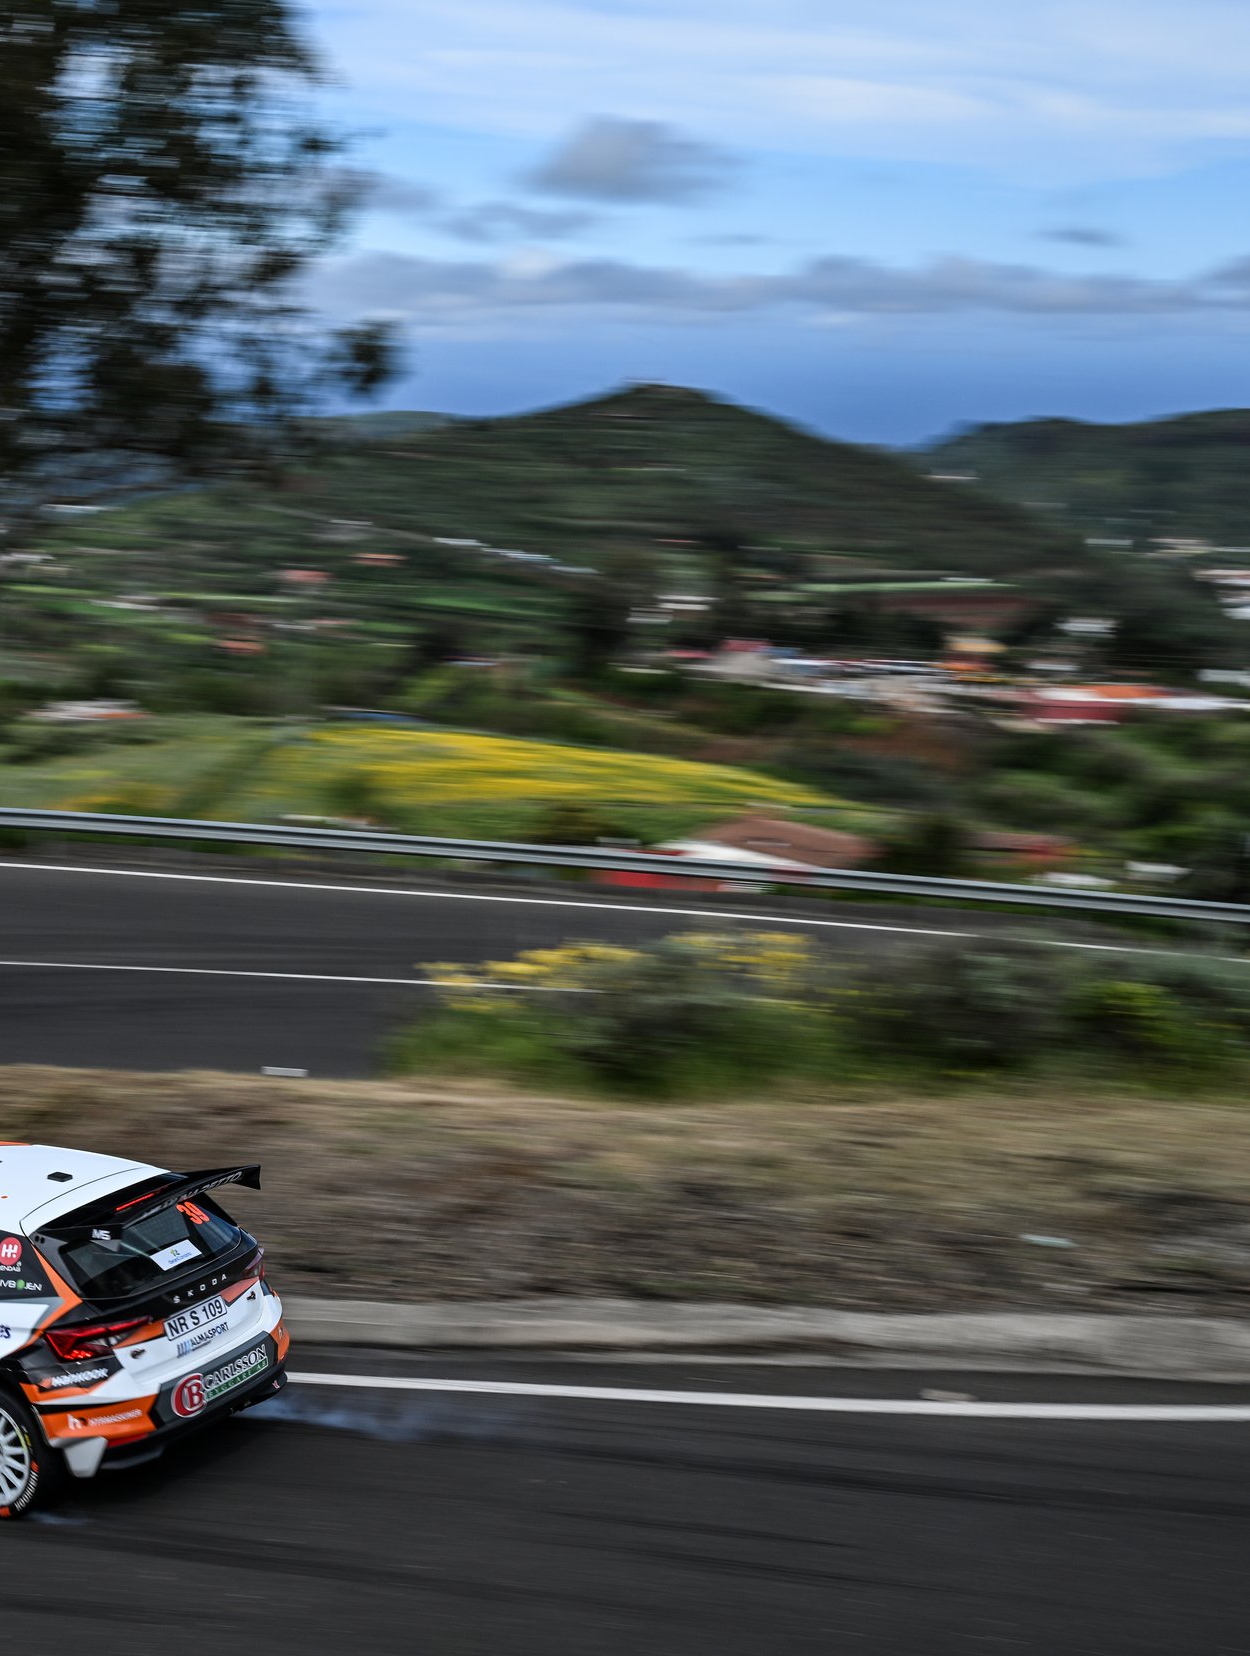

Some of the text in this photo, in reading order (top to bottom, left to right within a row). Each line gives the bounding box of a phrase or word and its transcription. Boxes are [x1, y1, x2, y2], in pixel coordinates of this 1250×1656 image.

[176, 1201, 210, 1225] 39
[166, 1299, 224, 1337] NR S 109
[190, 1321, 230, 1348] ALMASPORT
[202, 1343, 268, 1392] CARLSSON
